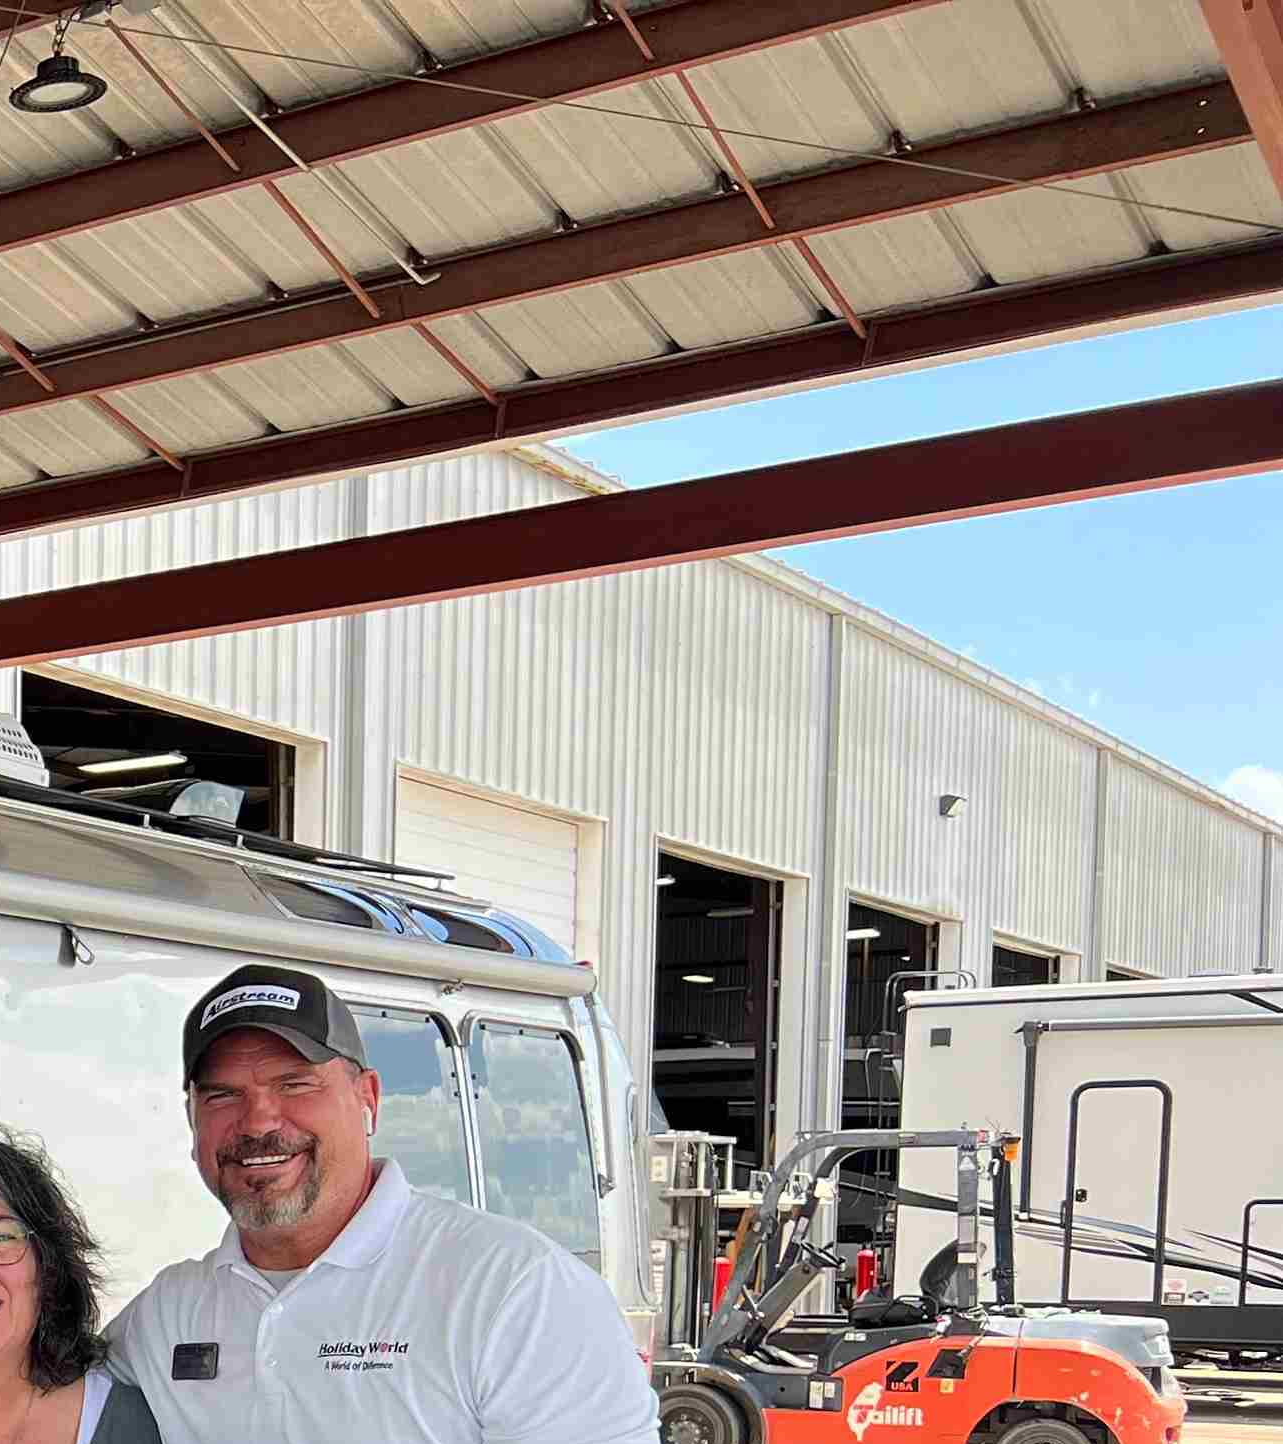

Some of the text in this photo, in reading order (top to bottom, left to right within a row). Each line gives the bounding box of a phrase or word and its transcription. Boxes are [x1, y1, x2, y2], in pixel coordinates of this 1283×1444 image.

[204, 991, 295, 1019] Airstream
[318, 1342, 409, 1357] Holiday World
[890, 1381, 914, 1391] USA
